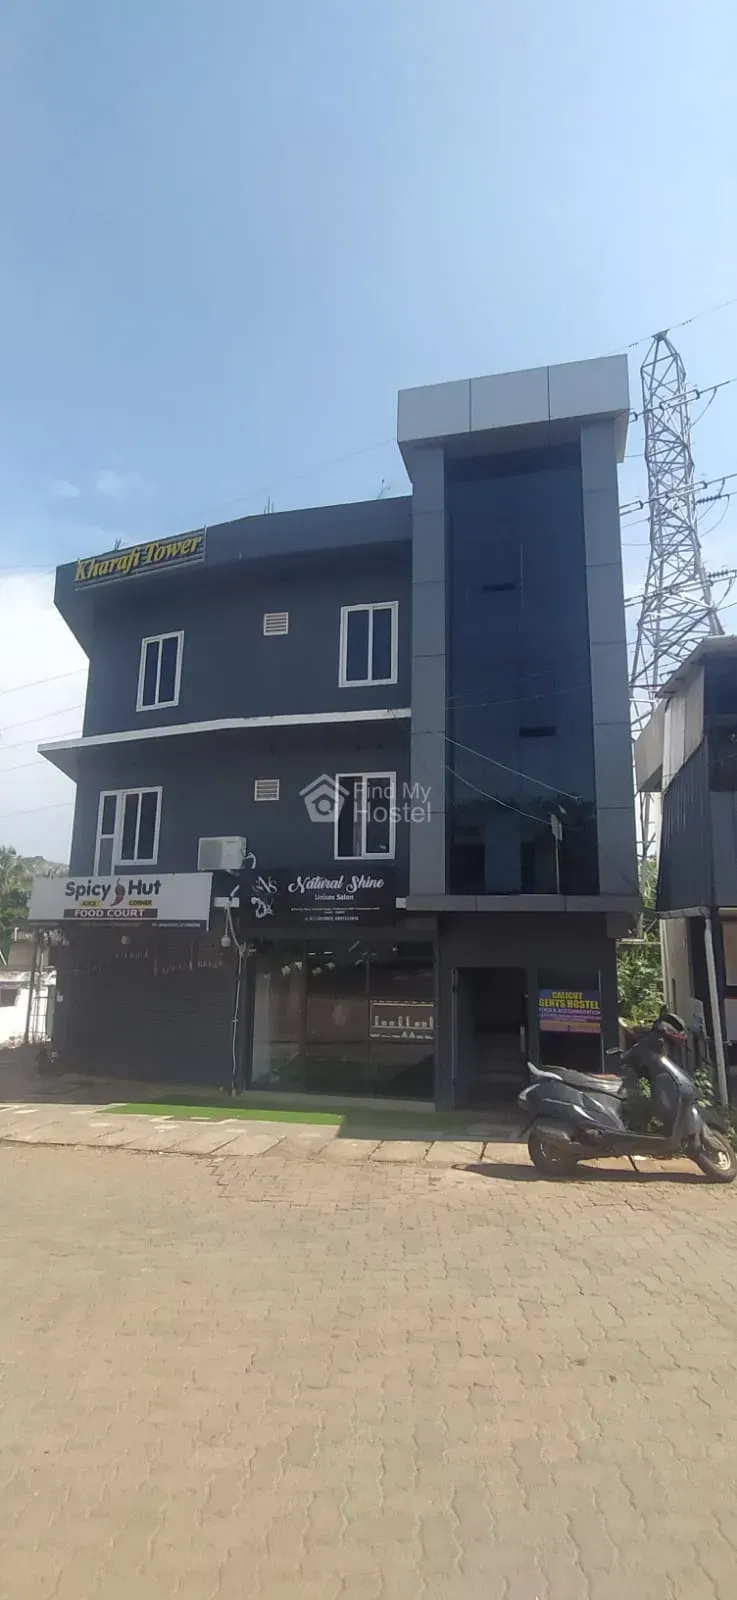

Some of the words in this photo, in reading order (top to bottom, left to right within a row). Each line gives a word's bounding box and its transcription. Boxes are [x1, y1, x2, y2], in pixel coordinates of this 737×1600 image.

[75, 547, 140, 581] Kharafi
[143, 536, 201, 563] Tower
[65, 880, 111, 901] Spicy
[128, 879, 161, 896] Hut
[288, 875, 344, 893] Natural
[346, 874, 385, 893] Shine
[74, 909, 104, 917] FOOD
[106, 909, 144, 917] COURT
[567, 999, 600, 1009] HOSTEL
